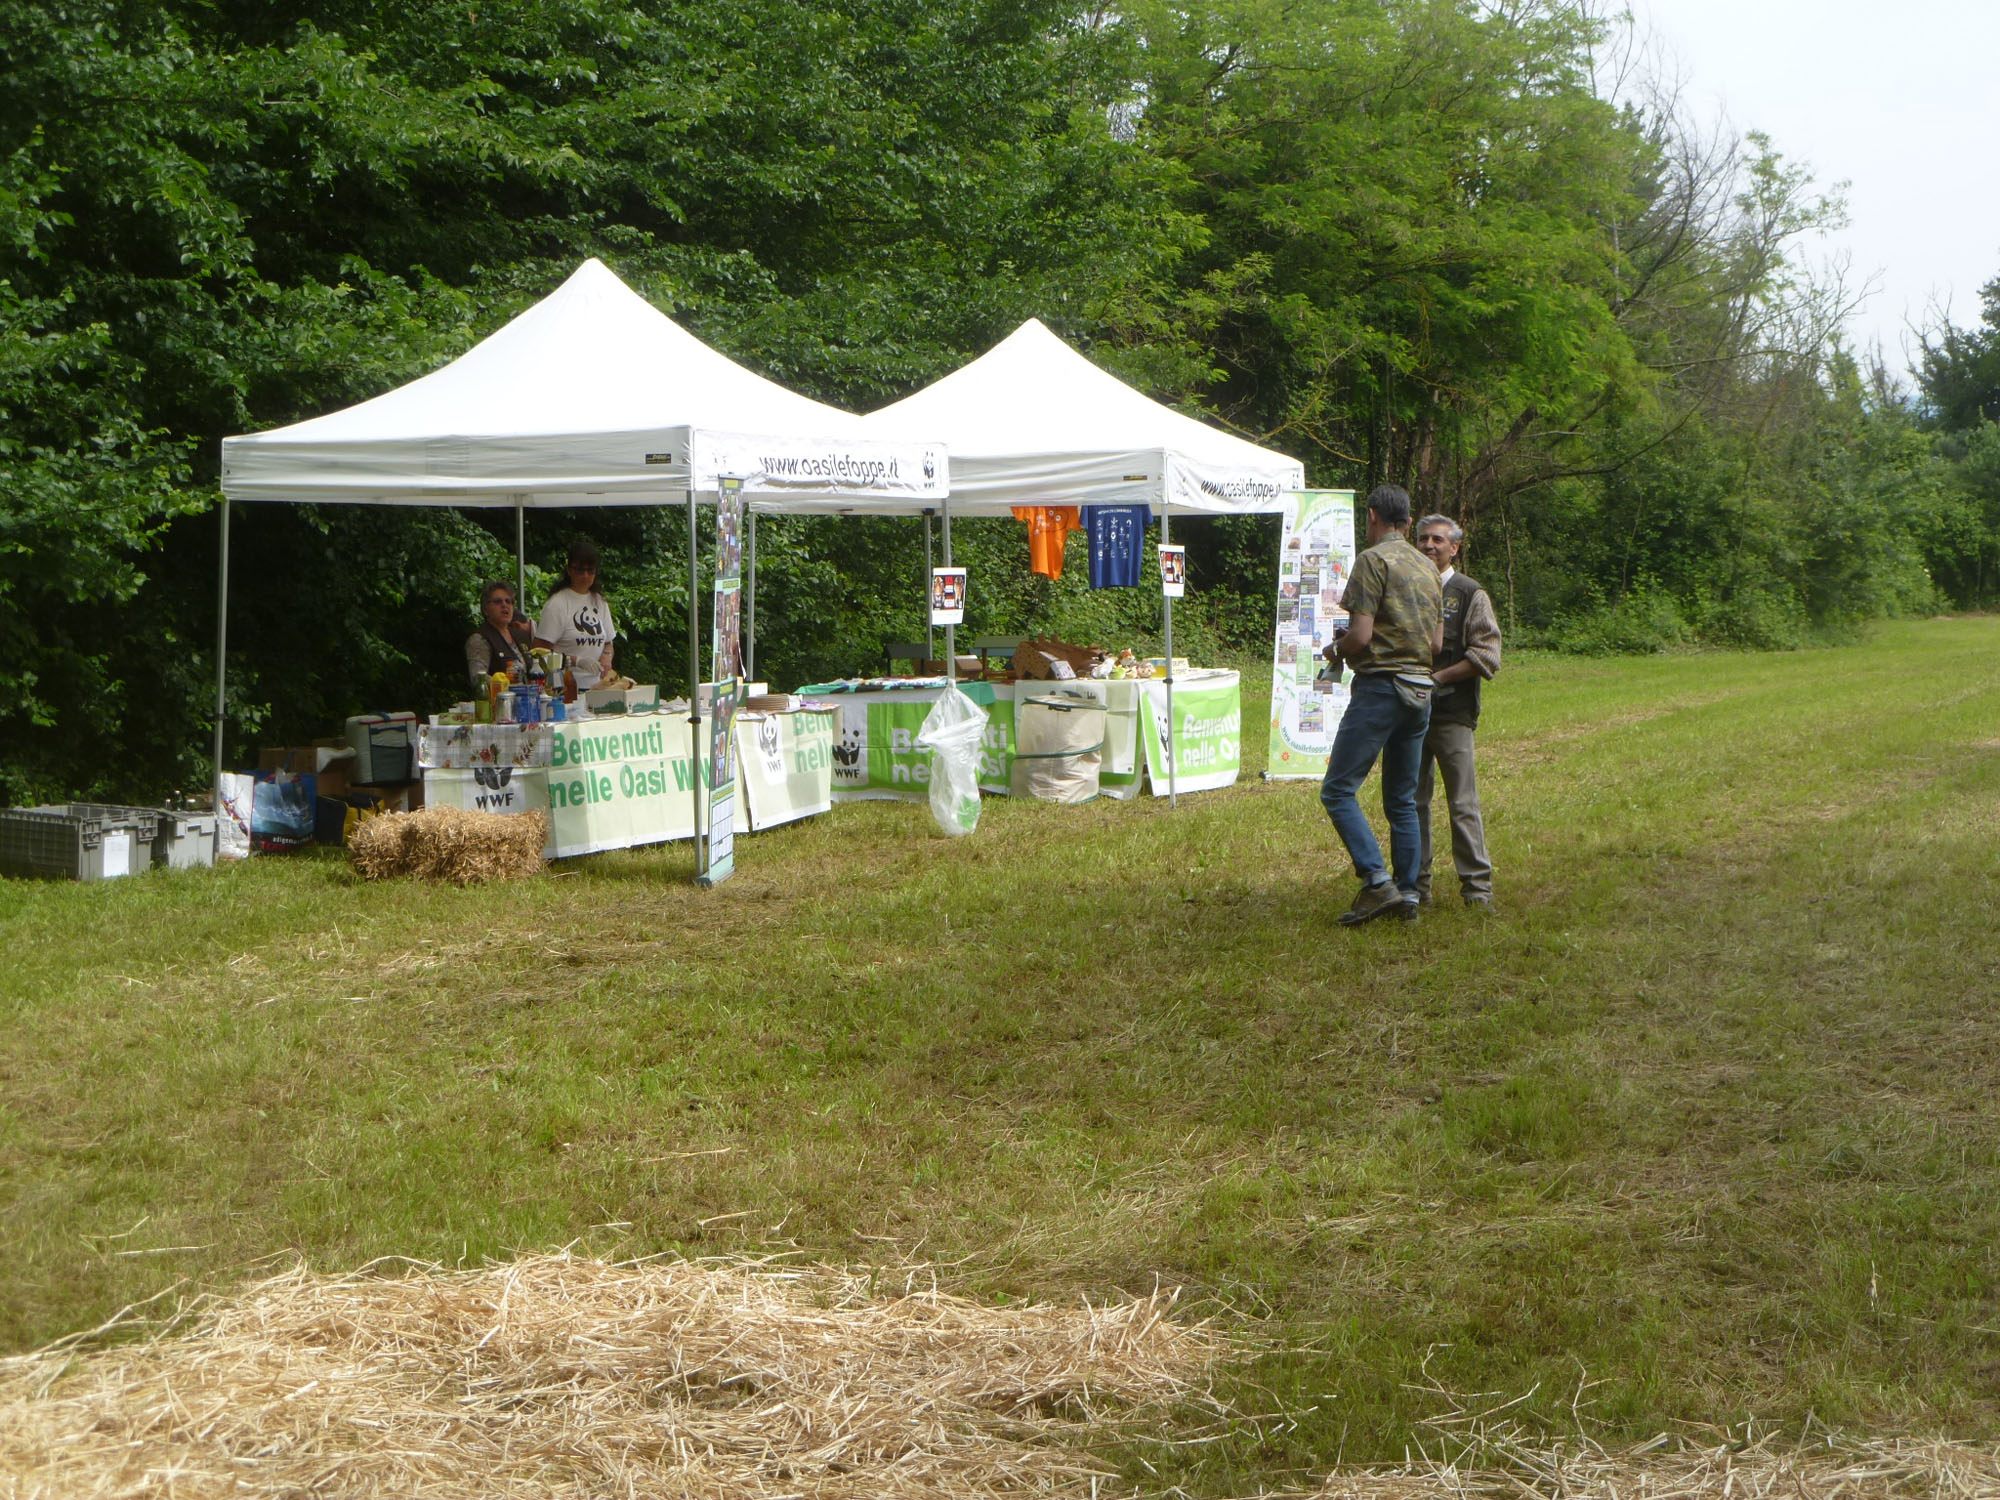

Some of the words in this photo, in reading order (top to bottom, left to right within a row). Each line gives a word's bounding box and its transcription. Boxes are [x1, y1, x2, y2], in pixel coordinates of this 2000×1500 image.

[759, 454, 899, 484] www.oasilefoppe.it
[575, 637, 604, 648] WWF
[551, 721, 664, 767] Benvenuti
[1281, 725, 1332, 754] www.oasilefoppe.i
[794, 736, 834, 774] nell
[1183, 741, 1217, 768] nelle
[547, 769, 614, 809] nelle
[619, 761, 667, 800] Oasi
[834, 767, 860, 780] WWF
[475, 792, 515, 810] WWF
